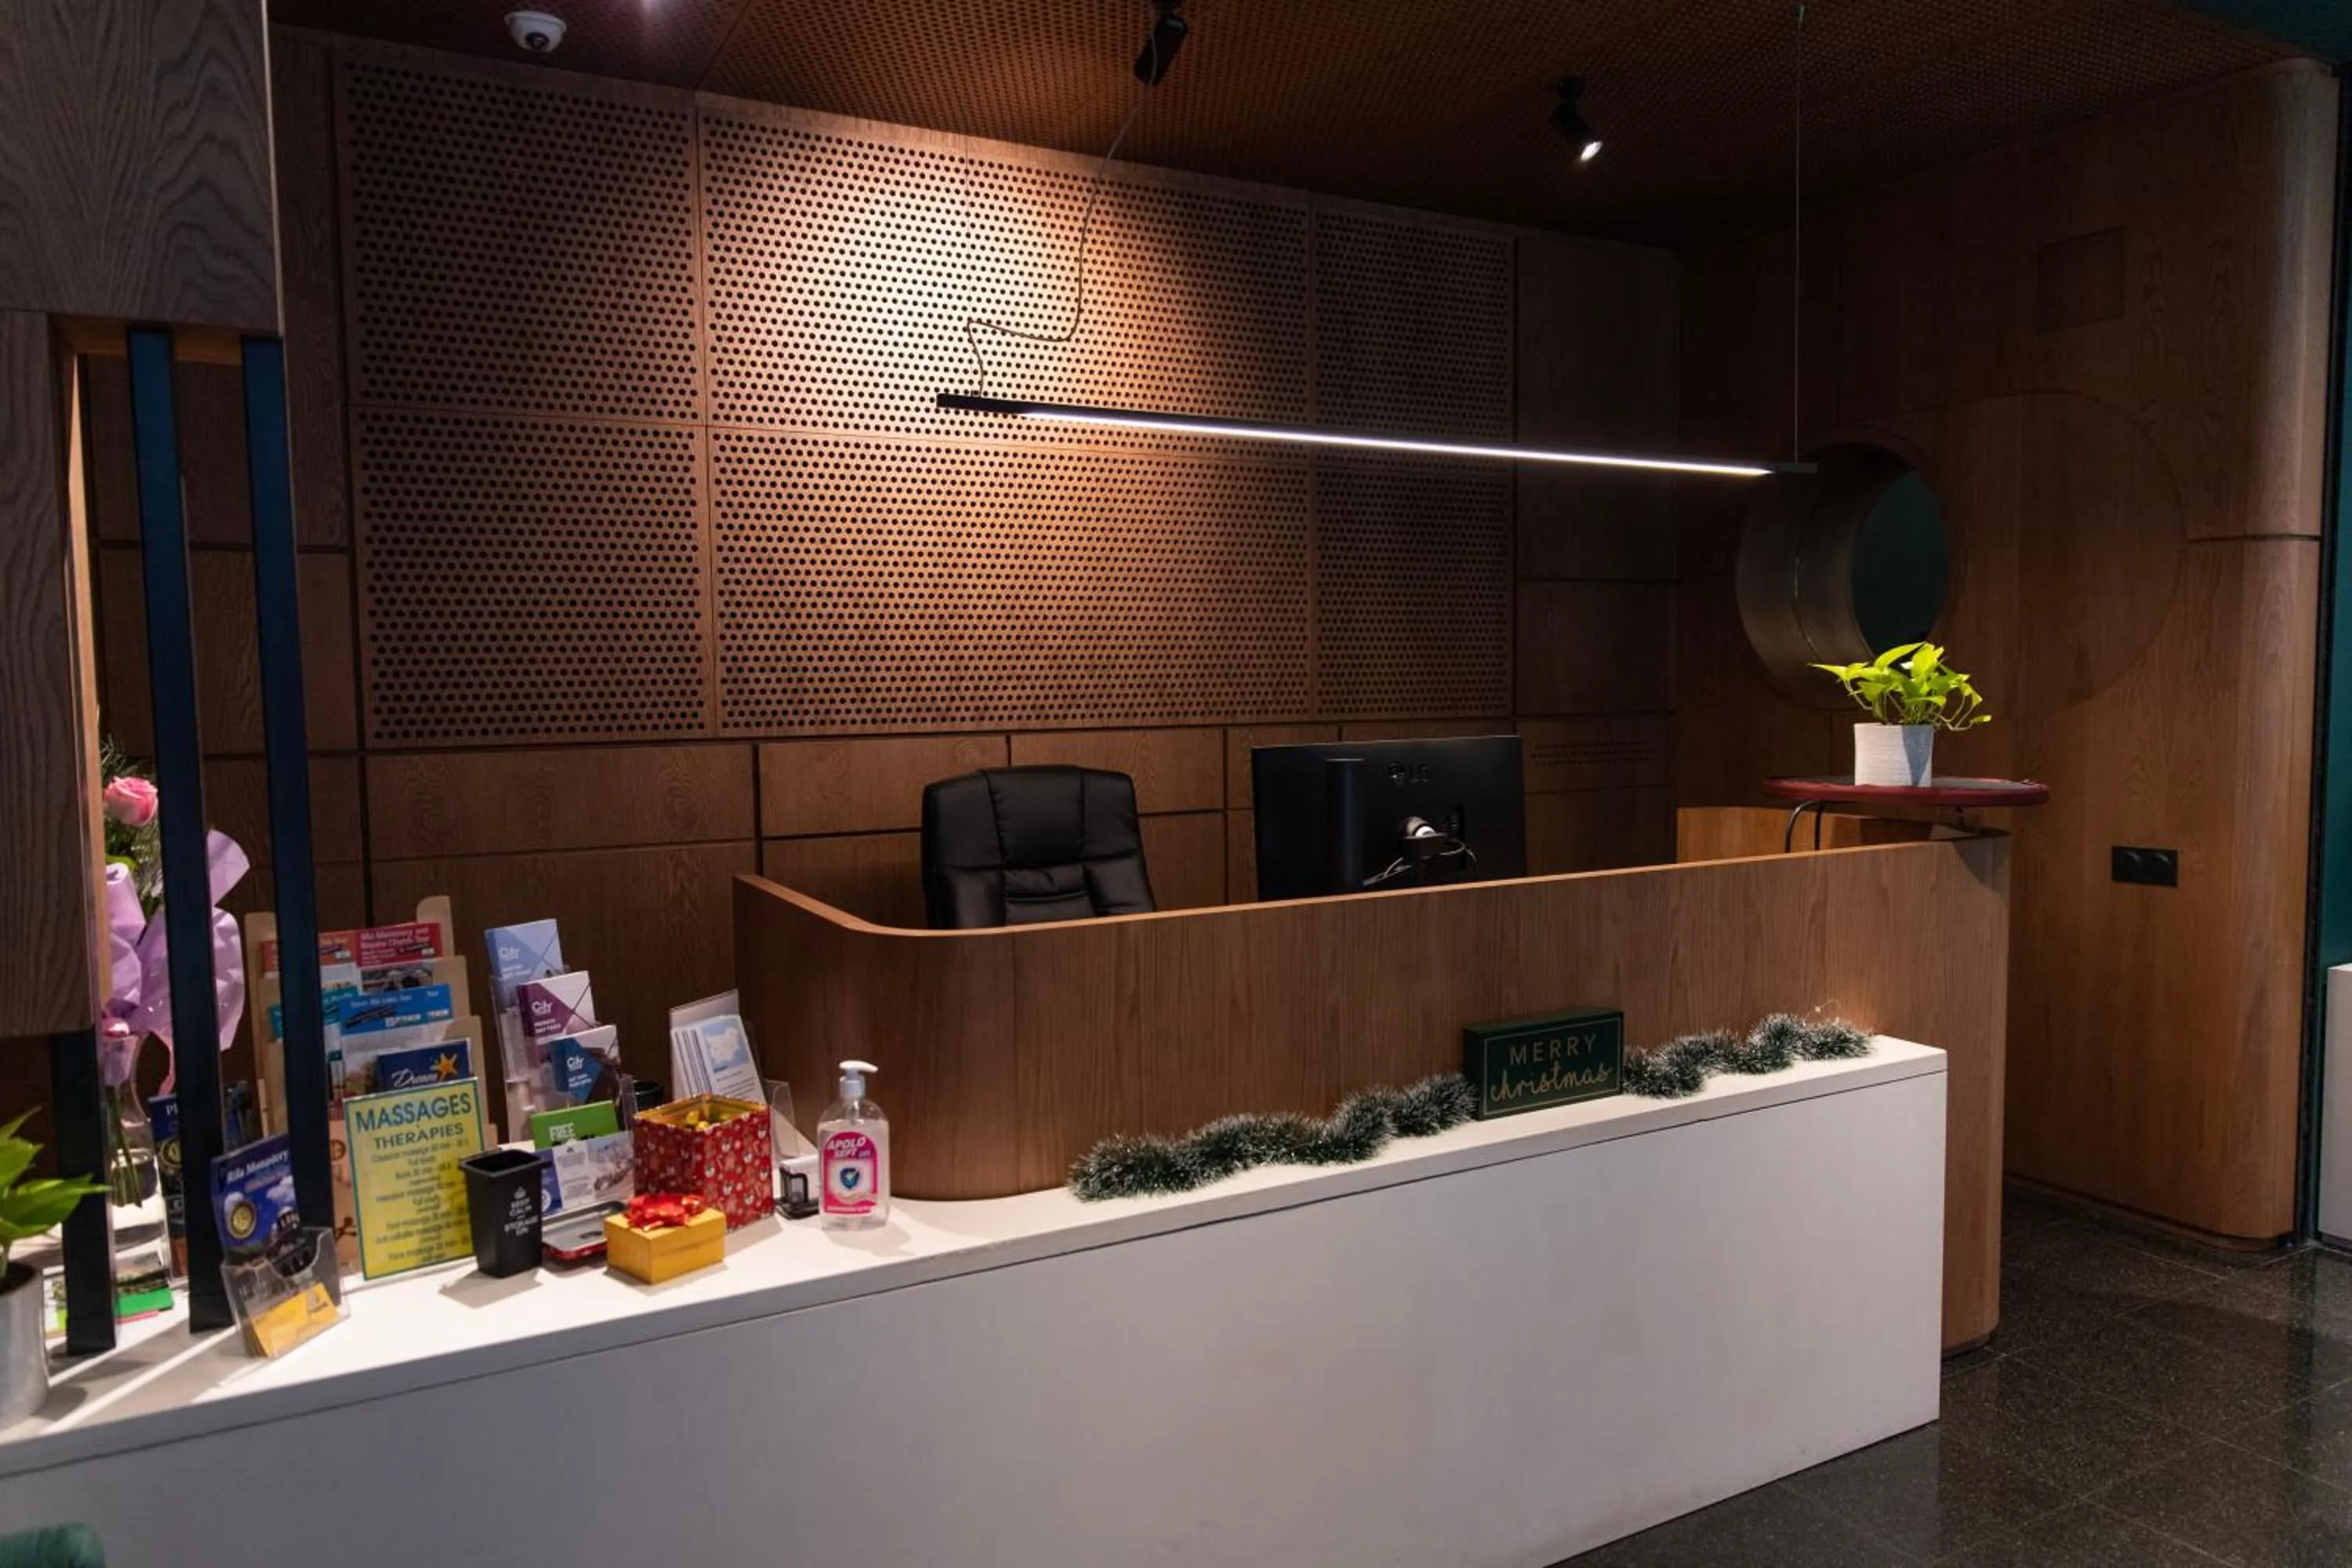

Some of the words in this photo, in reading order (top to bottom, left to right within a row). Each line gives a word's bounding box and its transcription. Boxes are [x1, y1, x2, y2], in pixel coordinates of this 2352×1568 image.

[1510, 1033, 1596, 1065] MERRY
[1490, 1059, 1614, 1102] christmas
[355, 1093, 472, 1132] MASSAGES
[374, 1122, 464, 1149] THERAPIES
[549, 1121, 576, 1142] FREE
[828, 1136, 866, 1149] APOLO
[246, 1150, 289, 1174] Monastery
